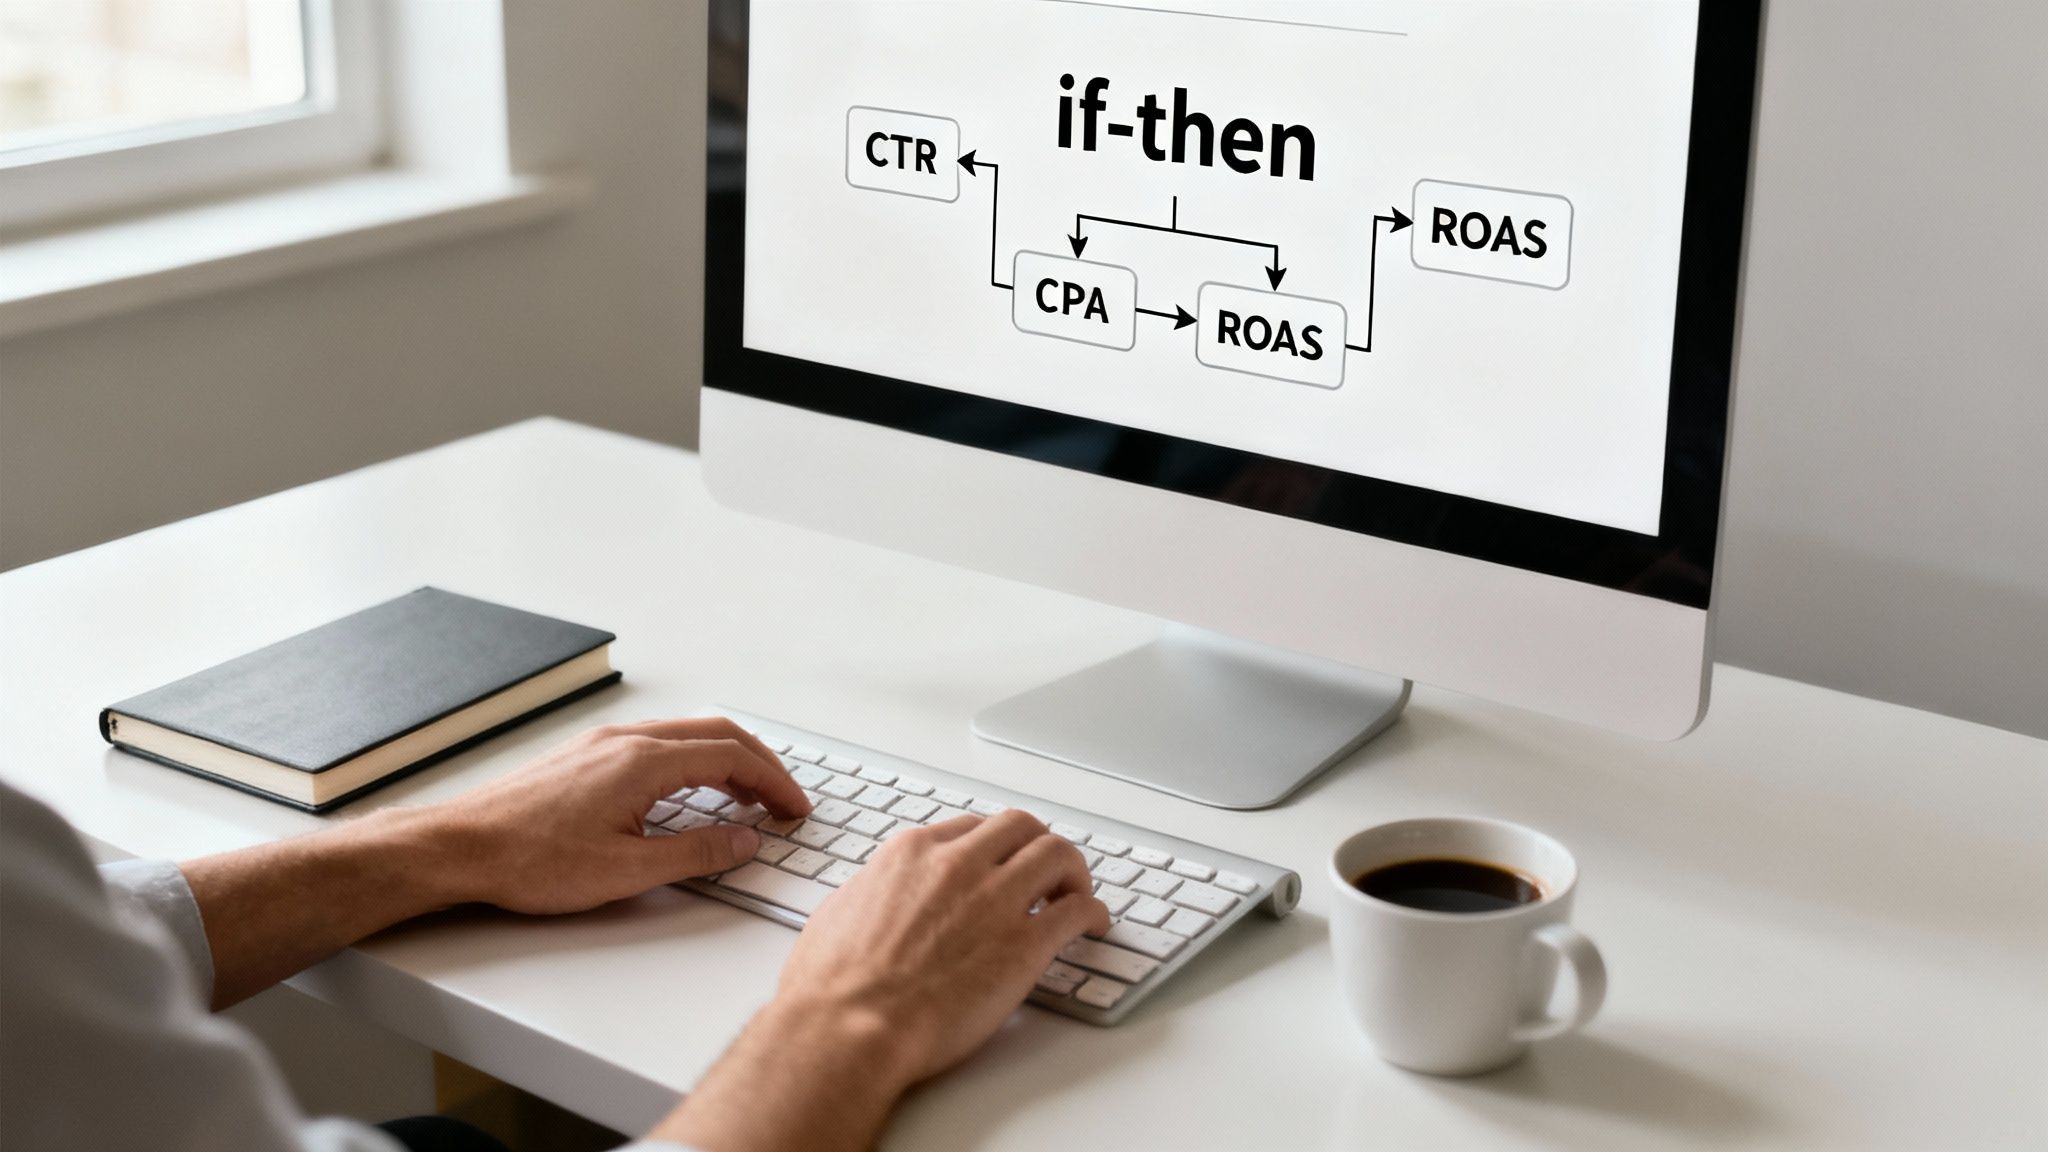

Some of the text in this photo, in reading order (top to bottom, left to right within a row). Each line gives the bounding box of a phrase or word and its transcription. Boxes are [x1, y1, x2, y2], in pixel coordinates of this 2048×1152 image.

[865, 131, 937, 175] CTR
[1057, 73, 1317, 182] if-then
[1431, 206, 1549, 259] ROAS
[1035, 277, 1110, 324] CPA
[1217, 309, 1325, 361] ROAS
